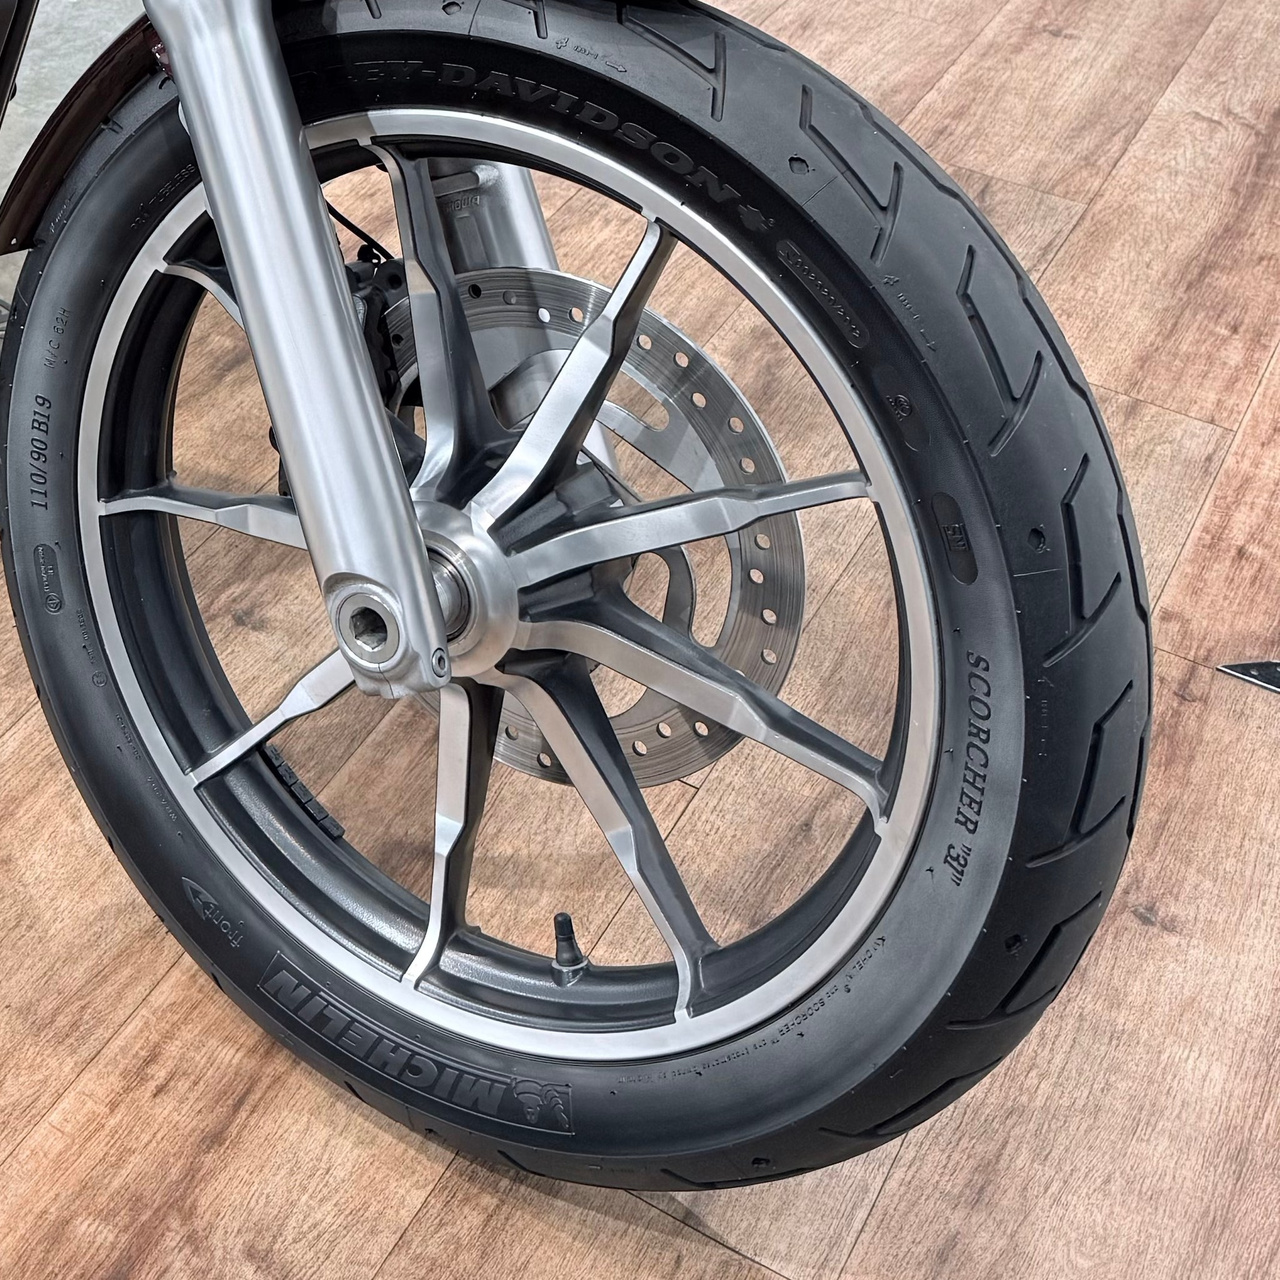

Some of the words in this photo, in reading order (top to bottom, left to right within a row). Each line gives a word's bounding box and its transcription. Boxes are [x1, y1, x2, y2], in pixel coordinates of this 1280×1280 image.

[32, 394, 52, 438] B19
[30, 437, 49, 512] 110/90
[954, 650, 992, 835] SCORCHER
[206, 902, 244, 949] front
[264, 970, 508, 1115] MICHELIN
